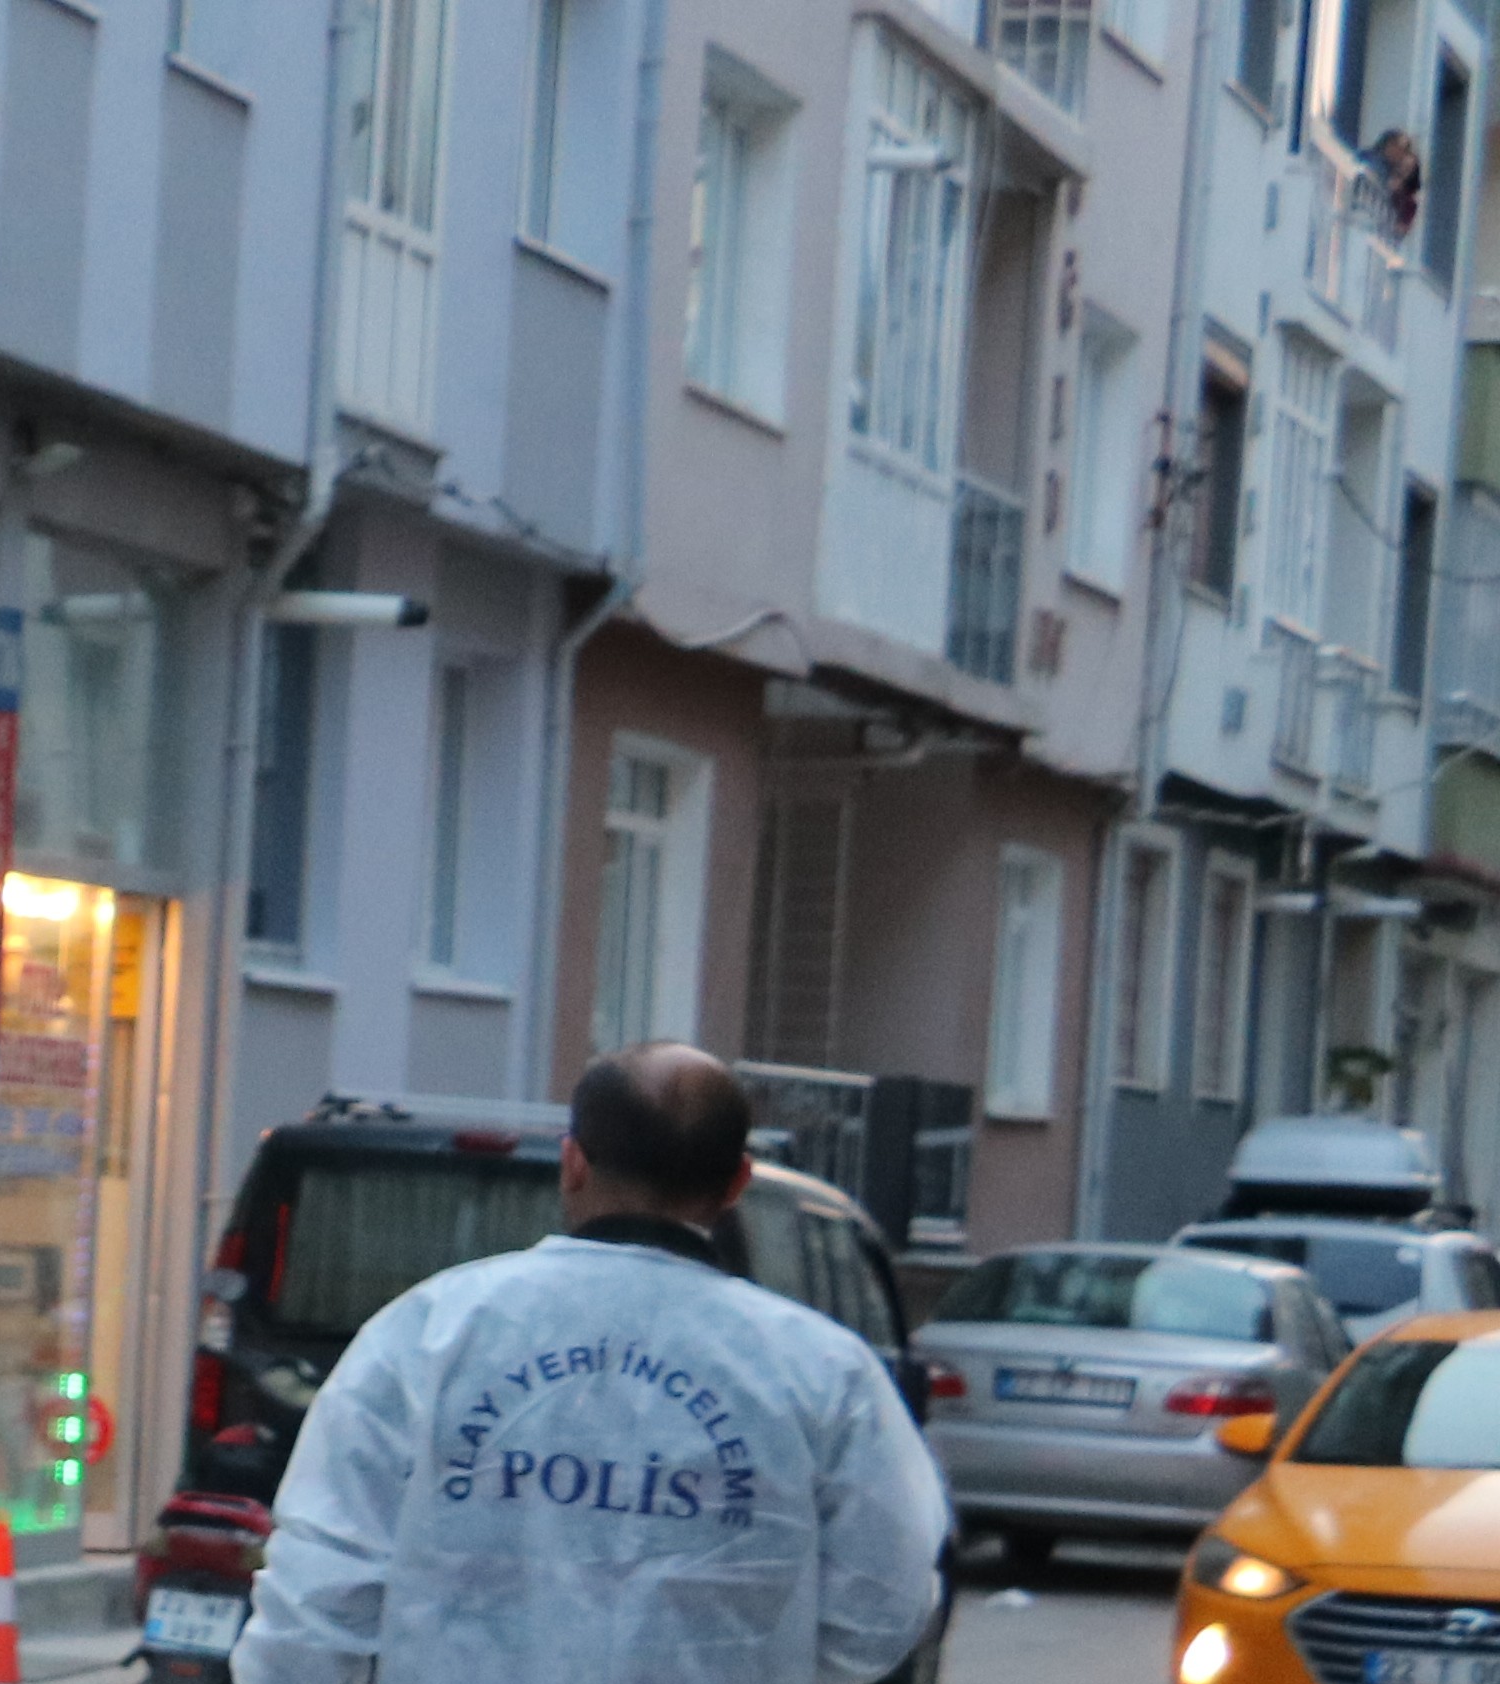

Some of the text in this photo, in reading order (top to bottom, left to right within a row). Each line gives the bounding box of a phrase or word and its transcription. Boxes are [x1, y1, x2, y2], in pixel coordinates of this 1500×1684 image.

[443, 1337, 756, 1529] OLAY YERİ İNCELEME
[500, 1448, 703, 1520] POLİS
